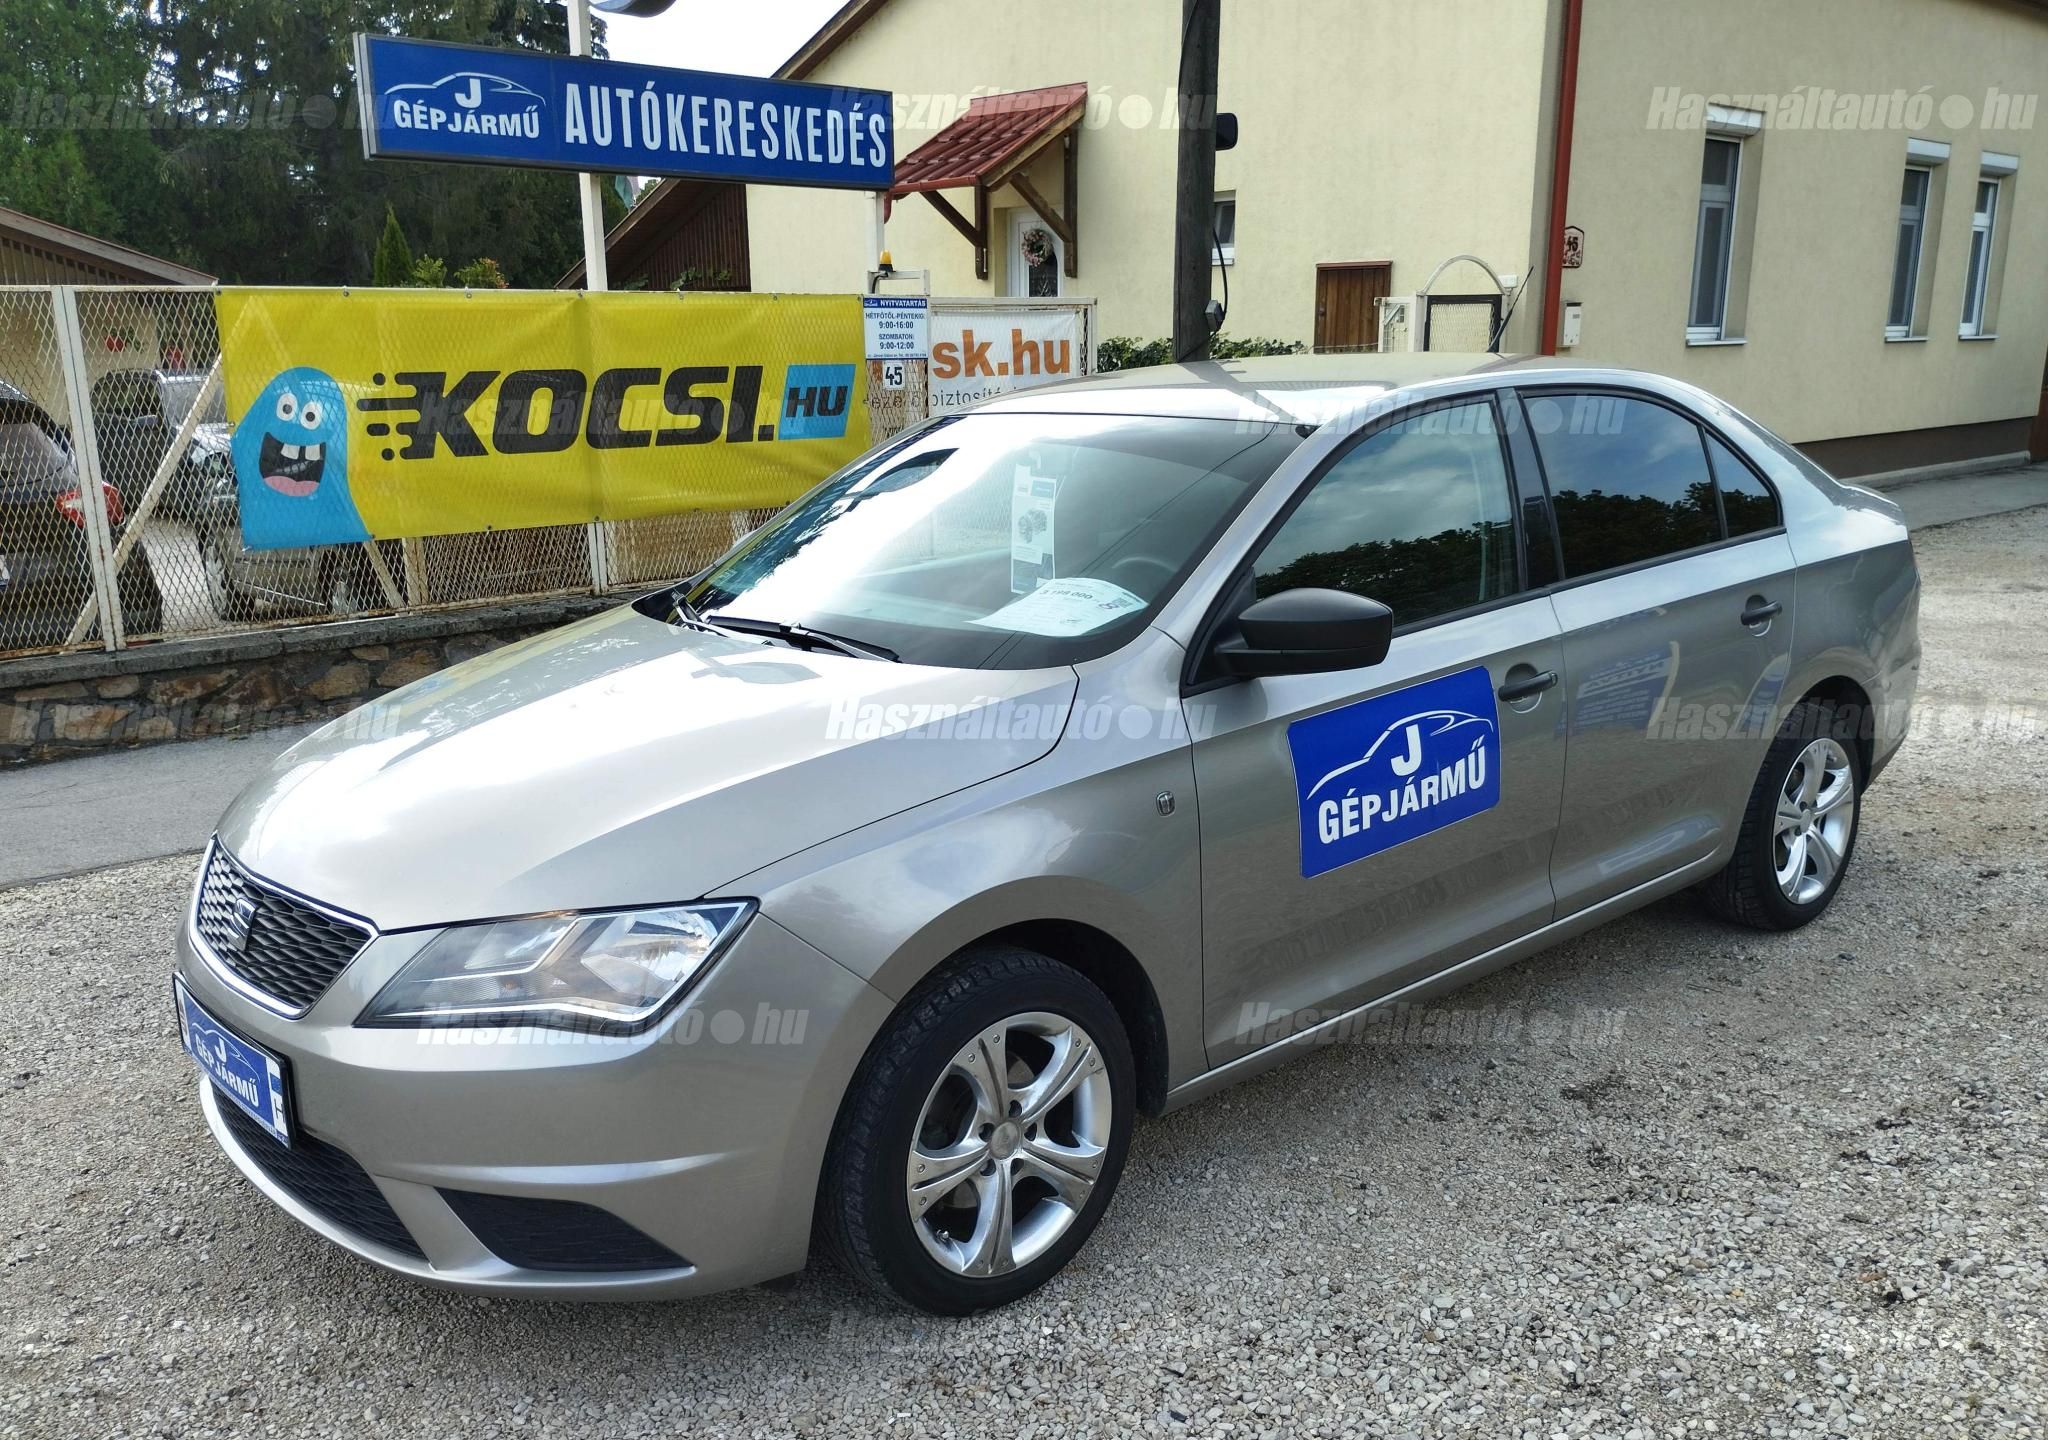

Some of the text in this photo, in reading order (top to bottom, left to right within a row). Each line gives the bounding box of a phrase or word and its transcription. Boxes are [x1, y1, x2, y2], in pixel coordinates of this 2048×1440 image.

[454, 79, 482, 109] J
[393, 98, 540, 140] GÉPJÁRMŰ
[565, 80, 887, 169] AUTÓKERESKEDÉS
[879, 321, 914, 329] 9:00-16:00
[879, 341, 915, 350] 9:00-12:00
[885, 366, 903, 386] 45
[1391, 723, 1422, 776] J
[1318, 734, 1487, 844] GÉPJÁRMŰ
